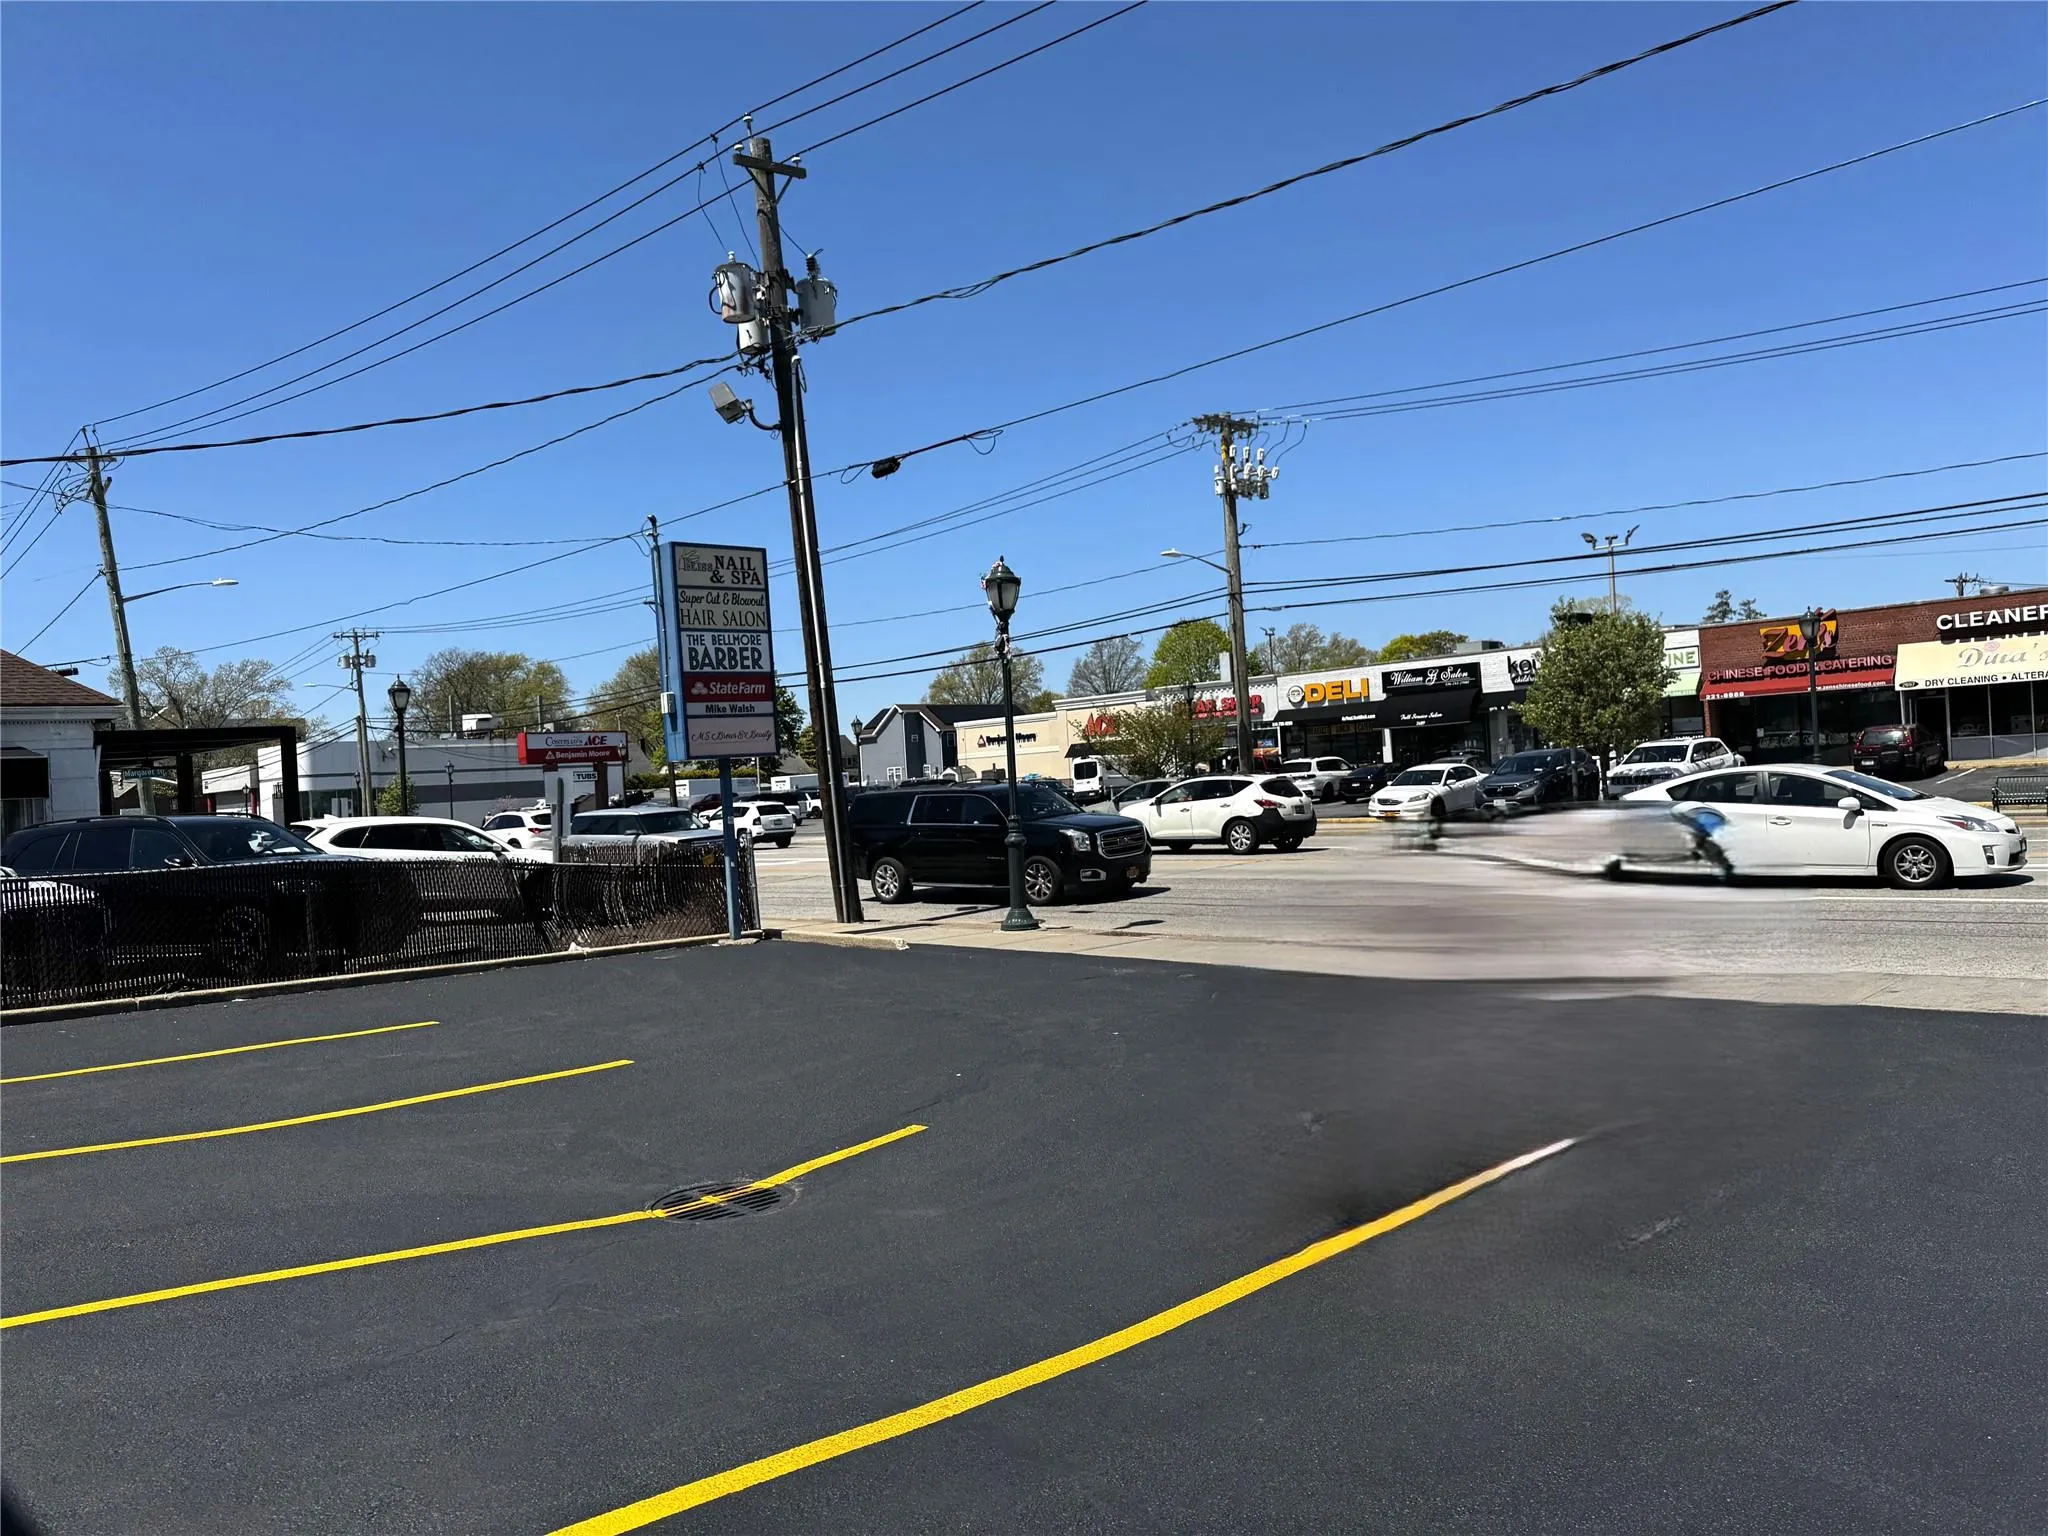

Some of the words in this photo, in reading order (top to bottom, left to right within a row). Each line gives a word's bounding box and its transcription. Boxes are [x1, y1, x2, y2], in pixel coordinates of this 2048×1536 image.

[714, 555, 756, 571] NAIL
[710, 570, 725, 584] &
[731, 571, 762, 586] SPA
[680, 590, 704, 608] Super
[706, 591, 721, 604] Cut
[722, 592, 730, 605] &
[731, 592, 764, 607] Blowout
[680, 608, 717, 626] HAIR
[722, 609, 766, 628] SALON
[686, 634, 706, 646] THE
[712, 634, 762, 646] BELLMORE
[688, 646, 764, 671] BARBER
[1390, 671, 1423, 686] William
[1425, 668, 1438, 686] G
[1440, 666, 1468, 681] Salon
[1707, 667, 1763, 681] CHINESE
[1769, 663, 1808, 676] FOOD
[1822, 655, 1892, 671] CATERING
[1924, 679, 1944, 688] DRY
[1948, 674, 1998, 686] CLEANING
[1304, 678, 1369, 702] DELI
[705, 704, 727, 714] Mike
[728, 703, 755, 714] Walsh
[1221, 694, 1262, 710] SHP
[1084, 712, 1116, 736] AC
[584, 736, 608, 746] ACE
[556, 750, 588, 760] Benjamin
[588, 750, 610, 758] Moore
